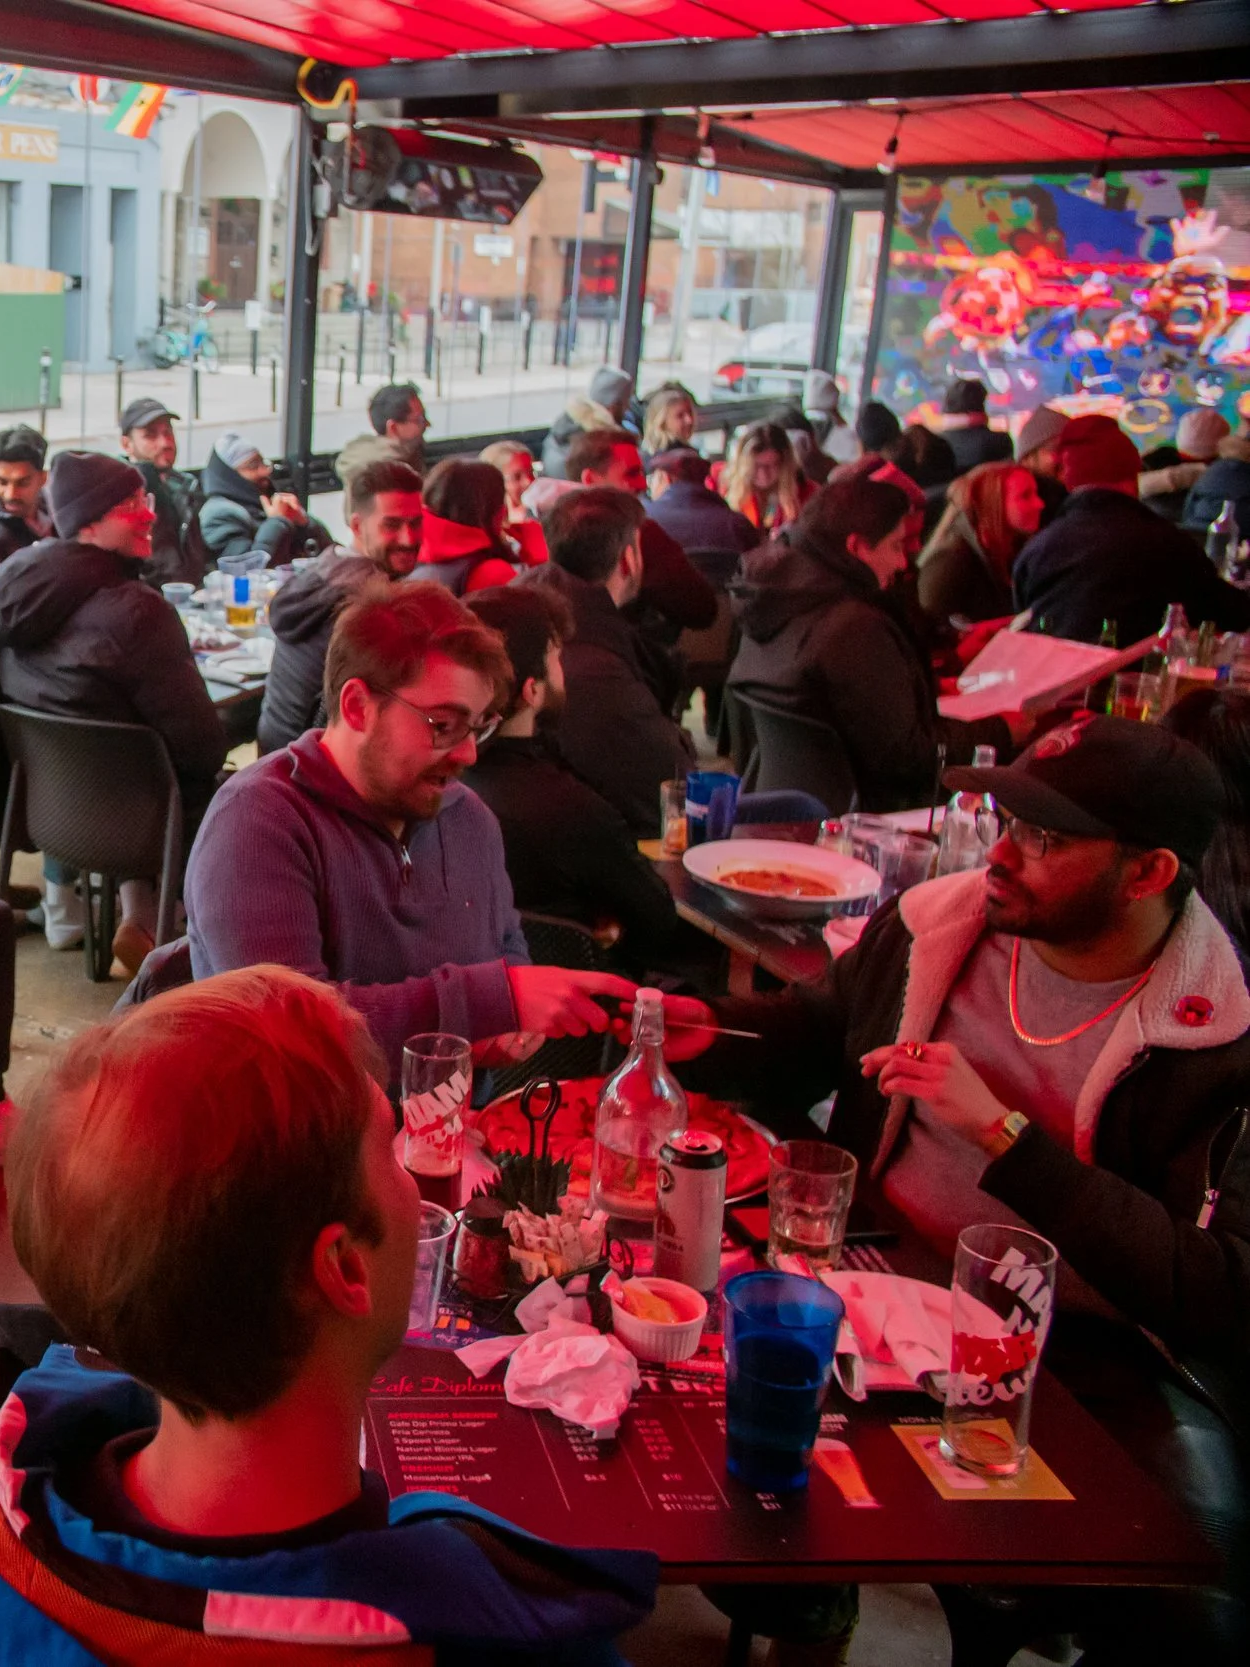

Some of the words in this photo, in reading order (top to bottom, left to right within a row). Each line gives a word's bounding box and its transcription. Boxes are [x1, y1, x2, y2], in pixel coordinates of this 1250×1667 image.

[10, 133, 59, 157] PENS
[369, 1375, 415, 1395] Café
[459, 1420, 487, 1429] Lager
[401, 1437, 432, 1446] Speed
[433, 1437, 461, 1446] Lager
[396, 1445, 433, 1453] Natural
[469, 1446, 499, 1454] Lager
[457, 1454, 476, 1462] IPA
